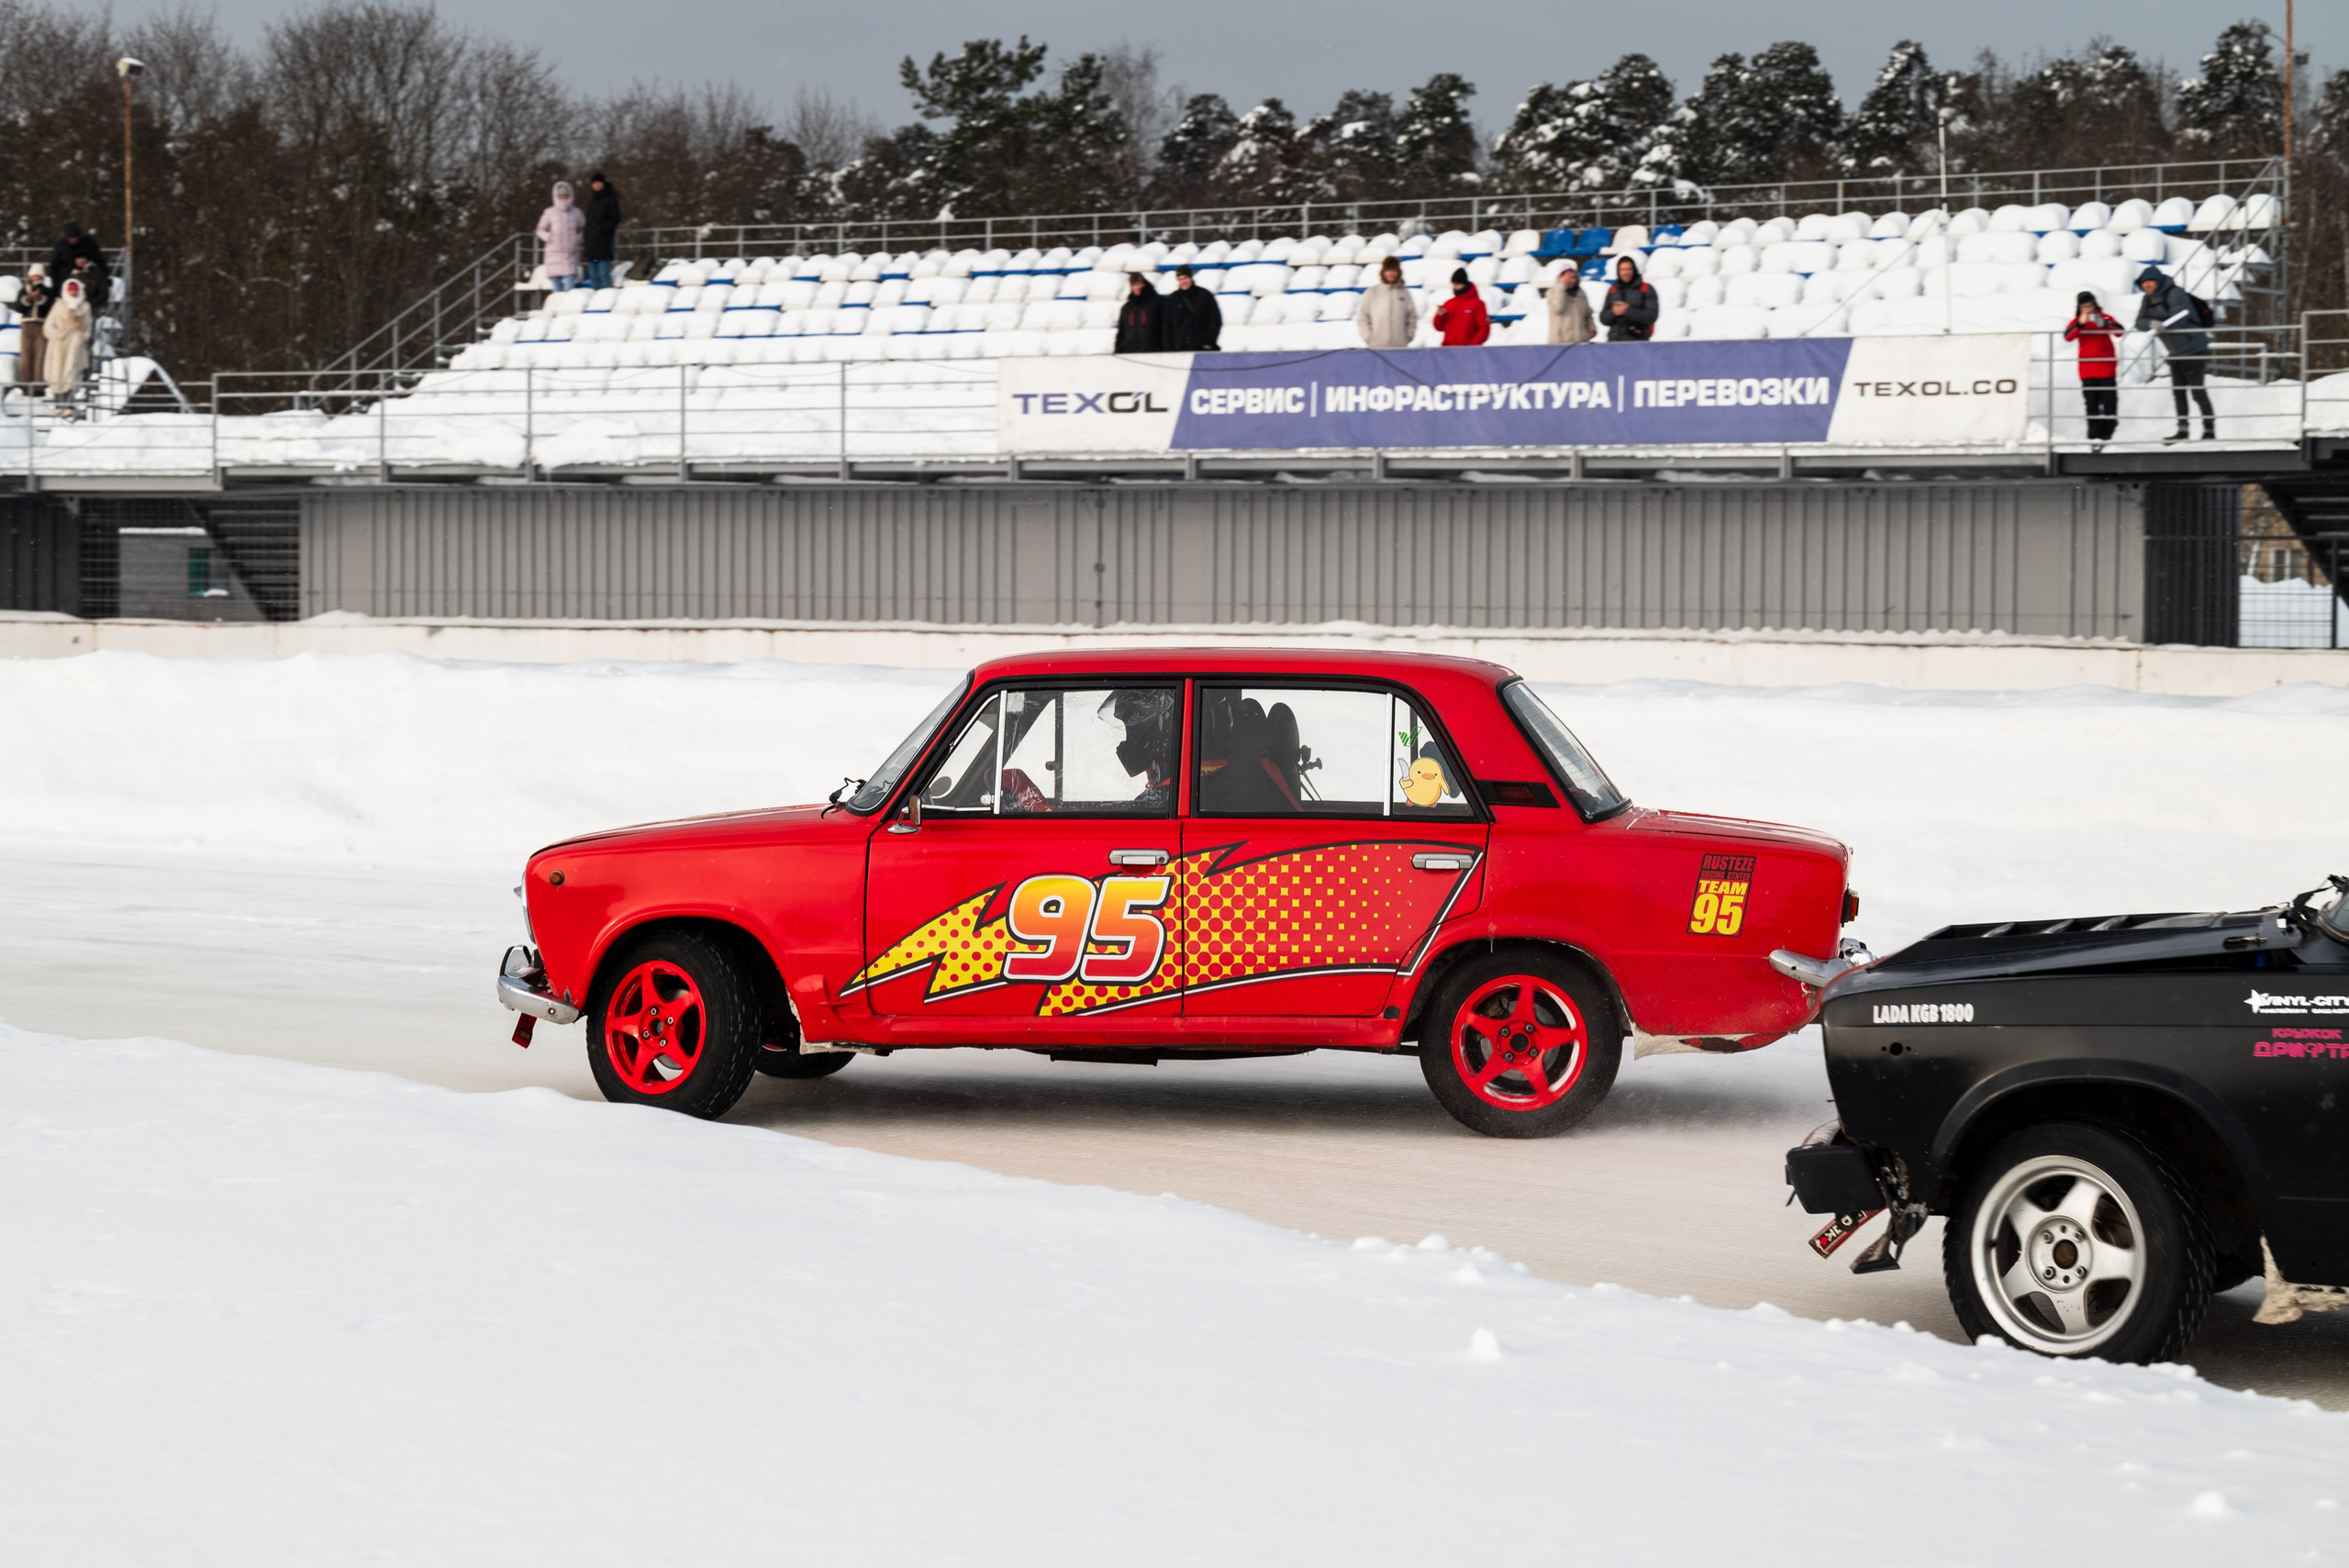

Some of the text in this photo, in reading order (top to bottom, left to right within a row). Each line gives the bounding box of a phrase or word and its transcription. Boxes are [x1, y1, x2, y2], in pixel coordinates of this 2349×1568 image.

[1191, 377, 1830, 414] СЕРВИС ИНФРАСТРУКТУРА ПЕРЕВОЗКИ
[1854, 380, 2018, 397] TEXOL.CO
[1012, 392, 1168, 415] TEXOL
[1702, 854, 1754, 872] RUSTEZE
[1698, 880, 1748, 895] TEAM
[1690, 893, 1744, 935] 95
[1002, 873, 1174, 984] 95
[1873, 1003, 1975, 1023] LADA KGB 1800
